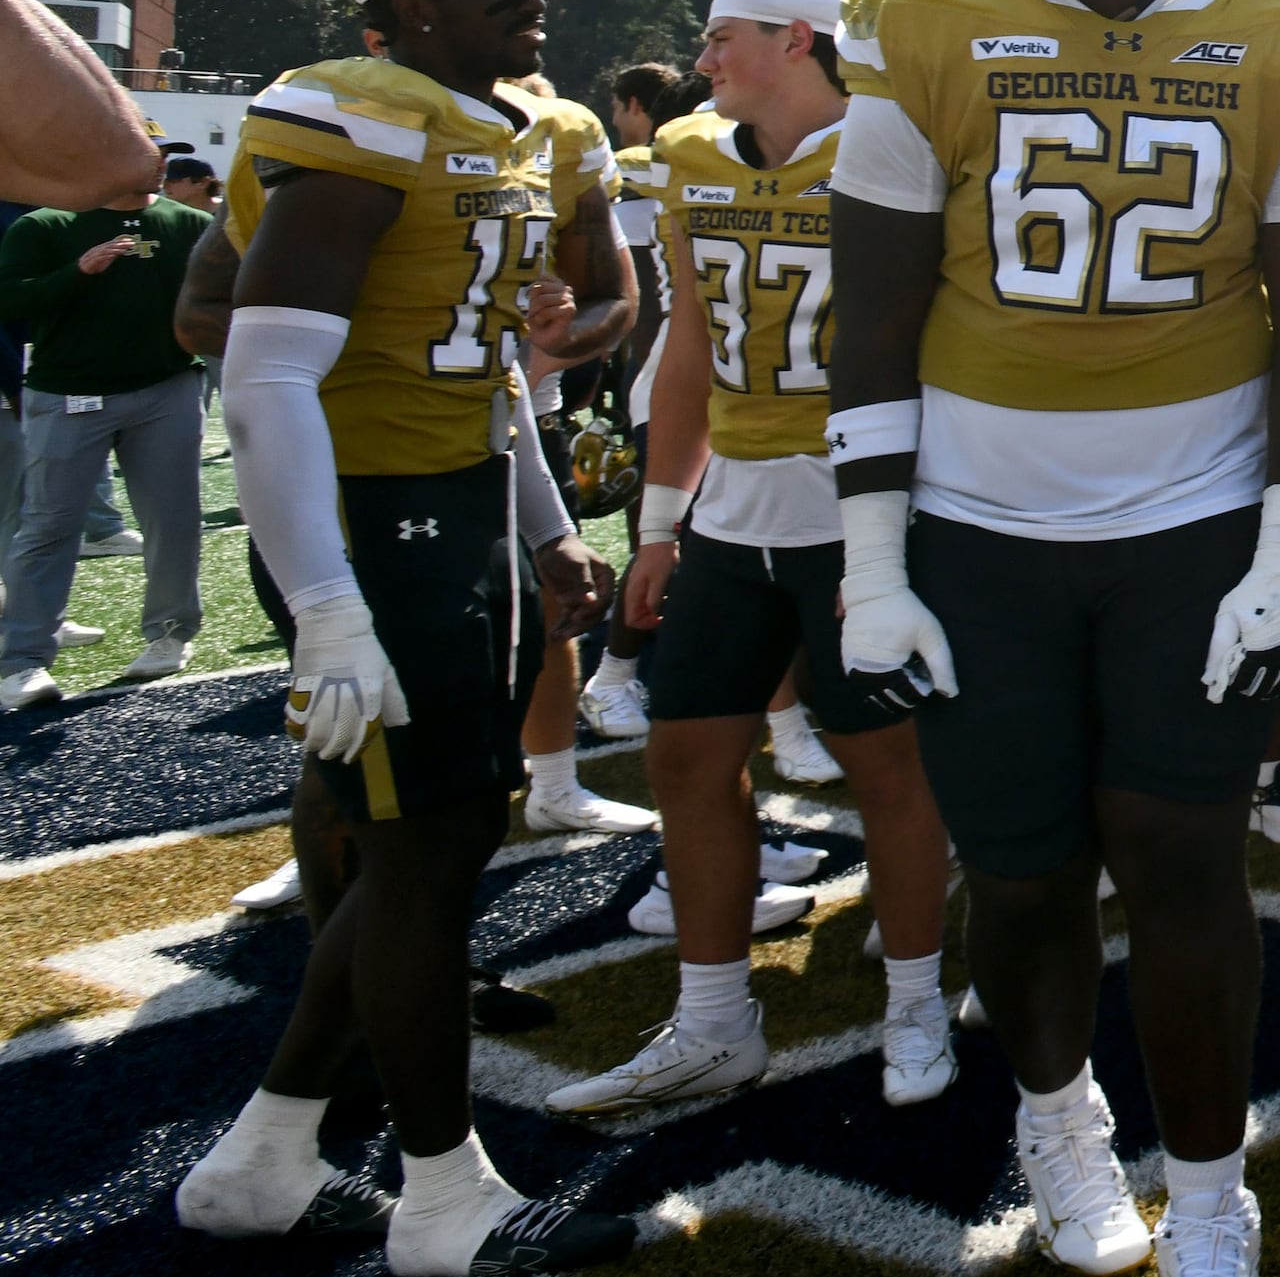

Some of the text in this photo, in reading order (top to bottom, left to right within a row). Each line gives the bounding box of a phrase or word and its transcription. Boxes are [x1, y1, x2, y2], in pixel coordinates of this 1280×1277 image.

[1186, 43, 1244, 61] ACC
[987, 71, 1241, 110] GEORGIA TECH
[689, 208, 831, 235] GEORGIA TEC
[985, 106, 1233, 314] 62
[690, 232, 833, 395] 37
